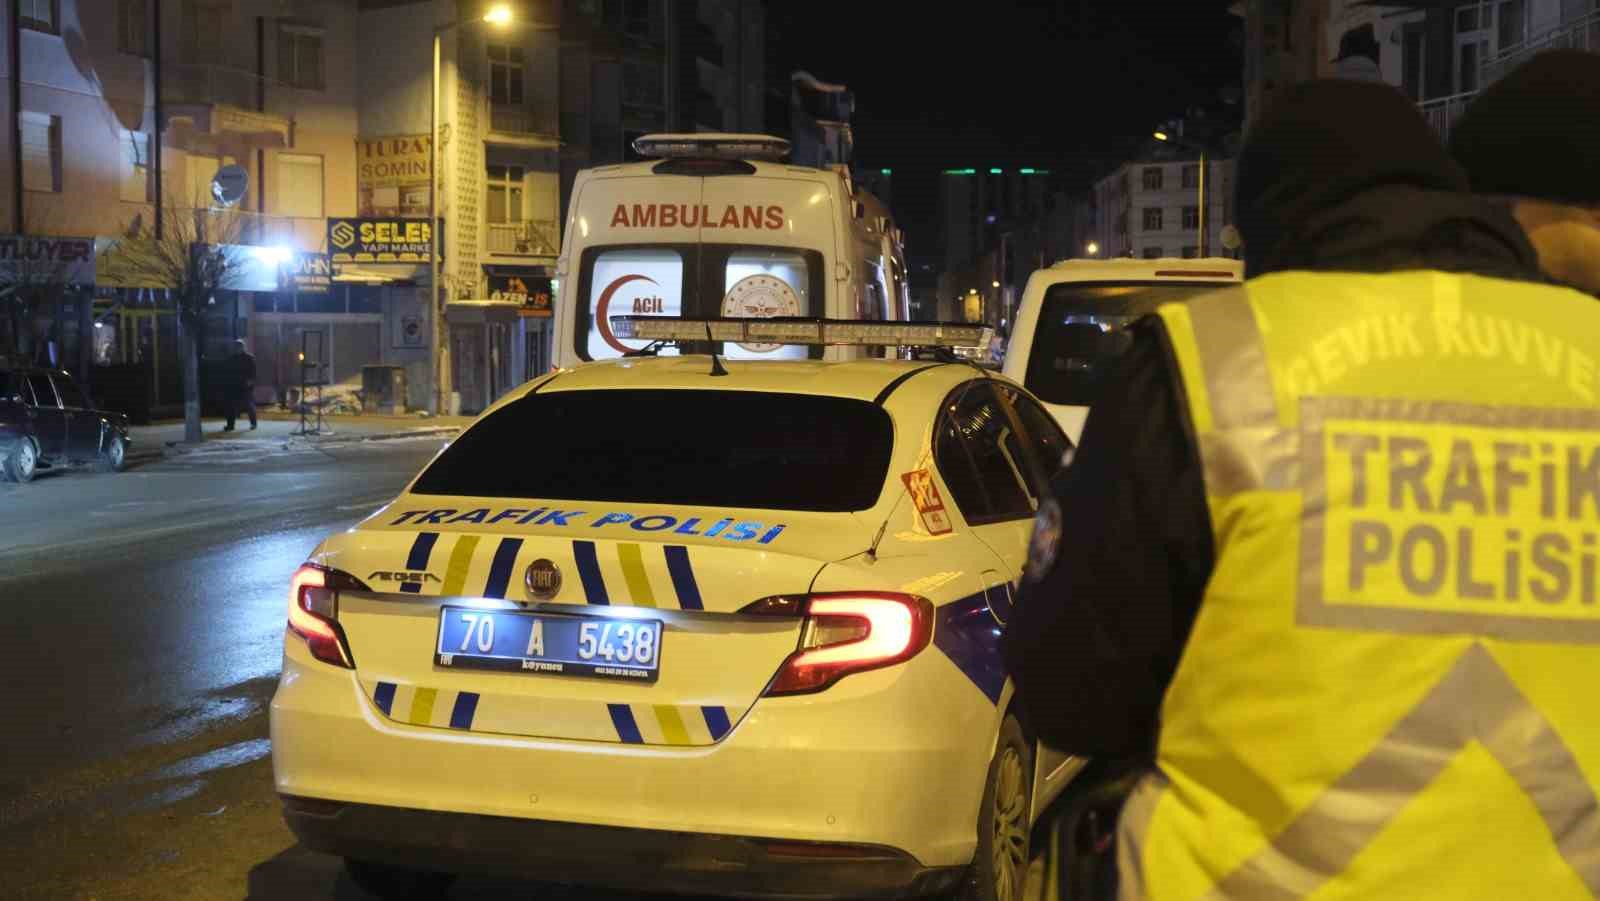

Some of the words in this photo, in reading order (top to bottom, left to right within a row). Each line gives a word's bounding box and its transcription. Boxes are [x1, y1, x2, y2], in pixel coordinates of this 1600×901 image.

[610, 204, 785, 230] AMBULANS
[362, 244, 388, 253] YAPI
[391, 245, 431, 254] MARKE
[1432, 311, 1598, 402] KUVVE
[460, 614, 495, 652] 70
[526, 619, 545, 657] A
[578, 622, 654, 664] 5438
